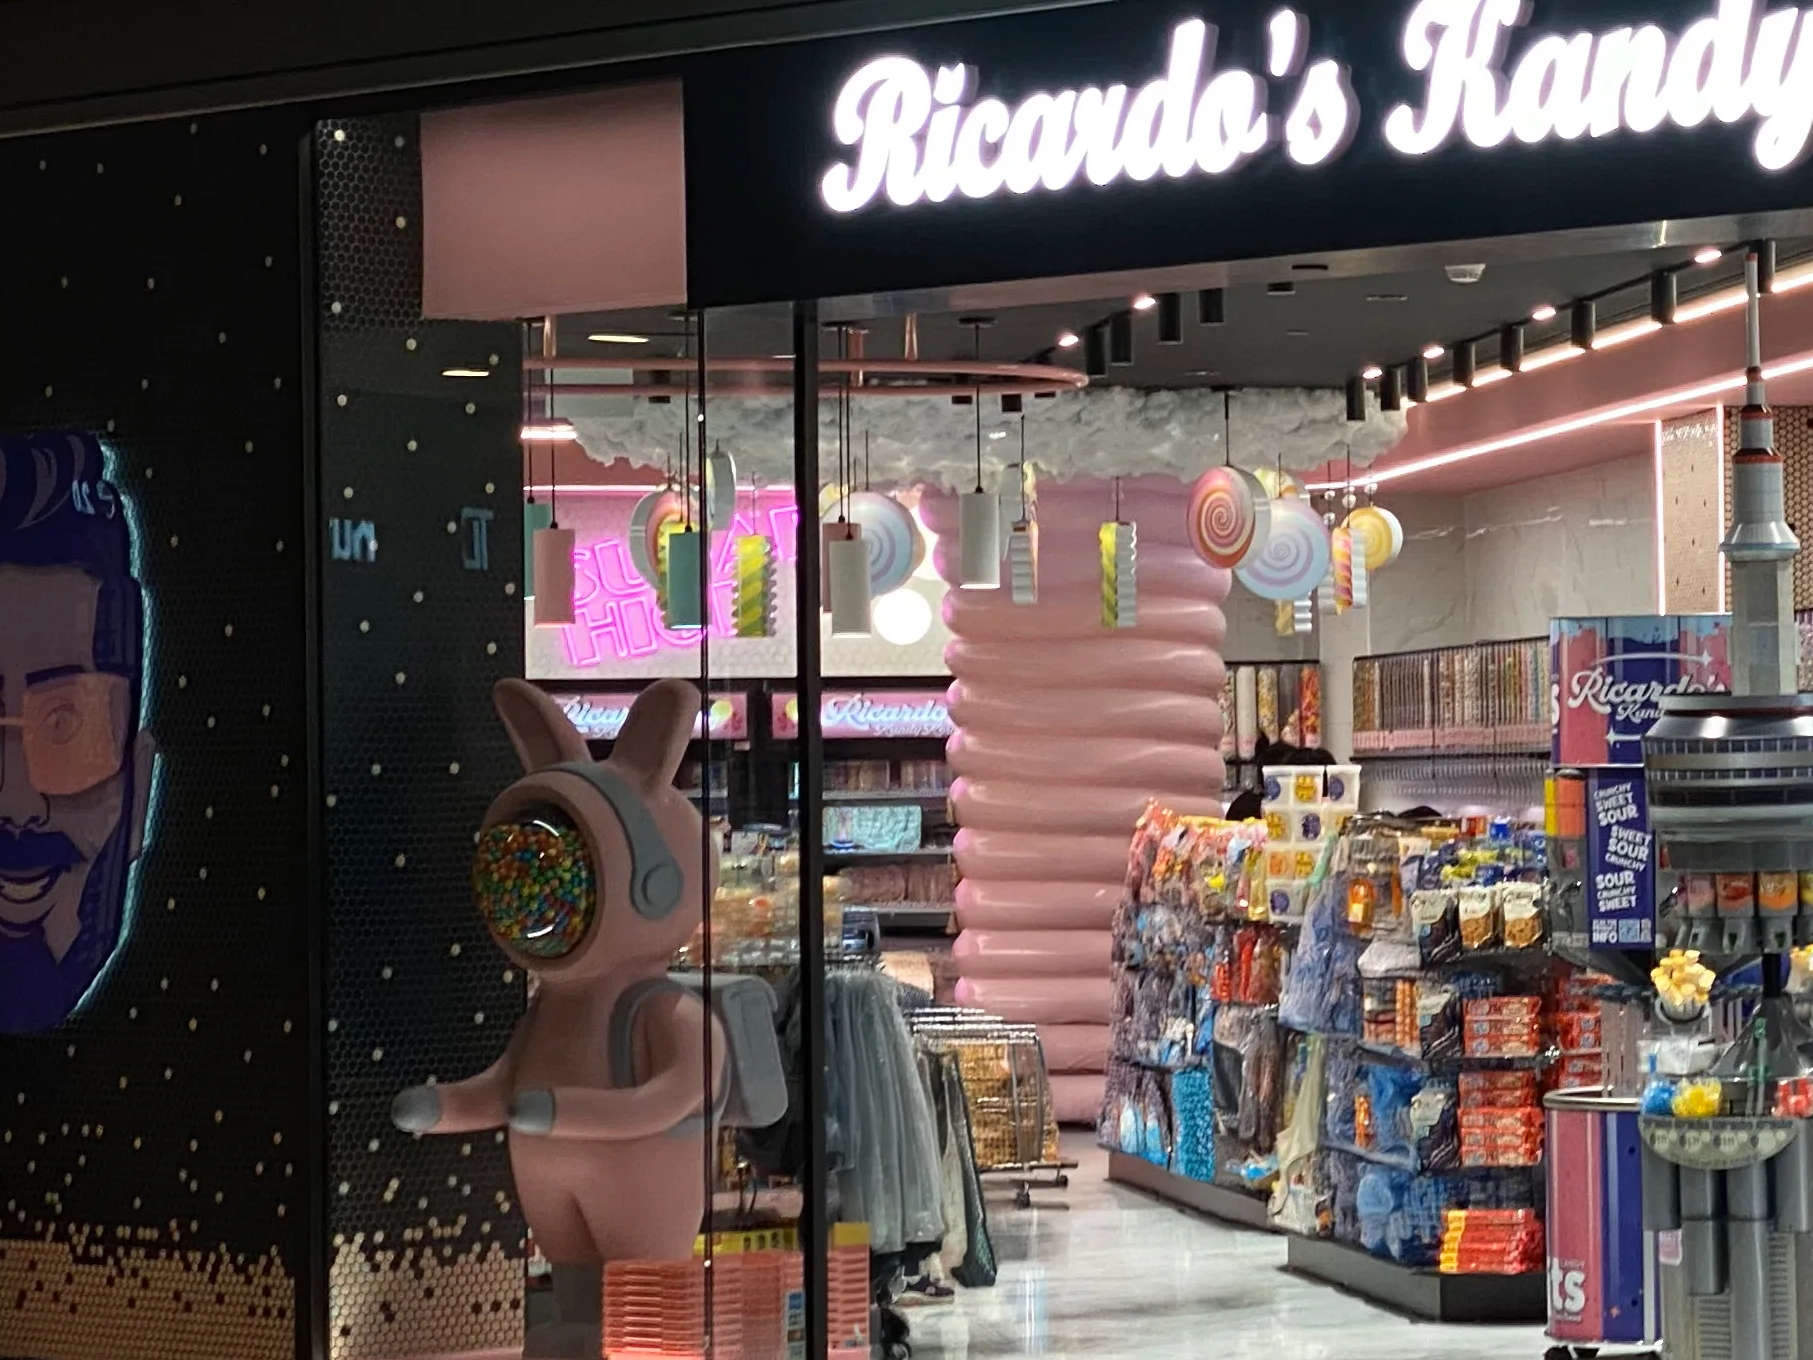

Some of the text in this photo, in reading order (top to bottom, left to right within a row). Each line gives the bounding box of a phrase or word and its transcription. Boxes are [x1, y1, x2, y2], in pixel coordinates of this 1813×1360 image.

[822, 10, 1348, 212] Ricardo's
[1595, 792, 1633, 813] SWEET
[1597, 804, 1639, 827] SOUR
[1610, 825, 1652, 846] SWEET
[1607, 838, 1649, 862] SOUR
[1595, 870, 1635, 890] SOUR
[1598, 895, 1637, 912] SWEET
[1592, 931, 1618, 943] INFO
